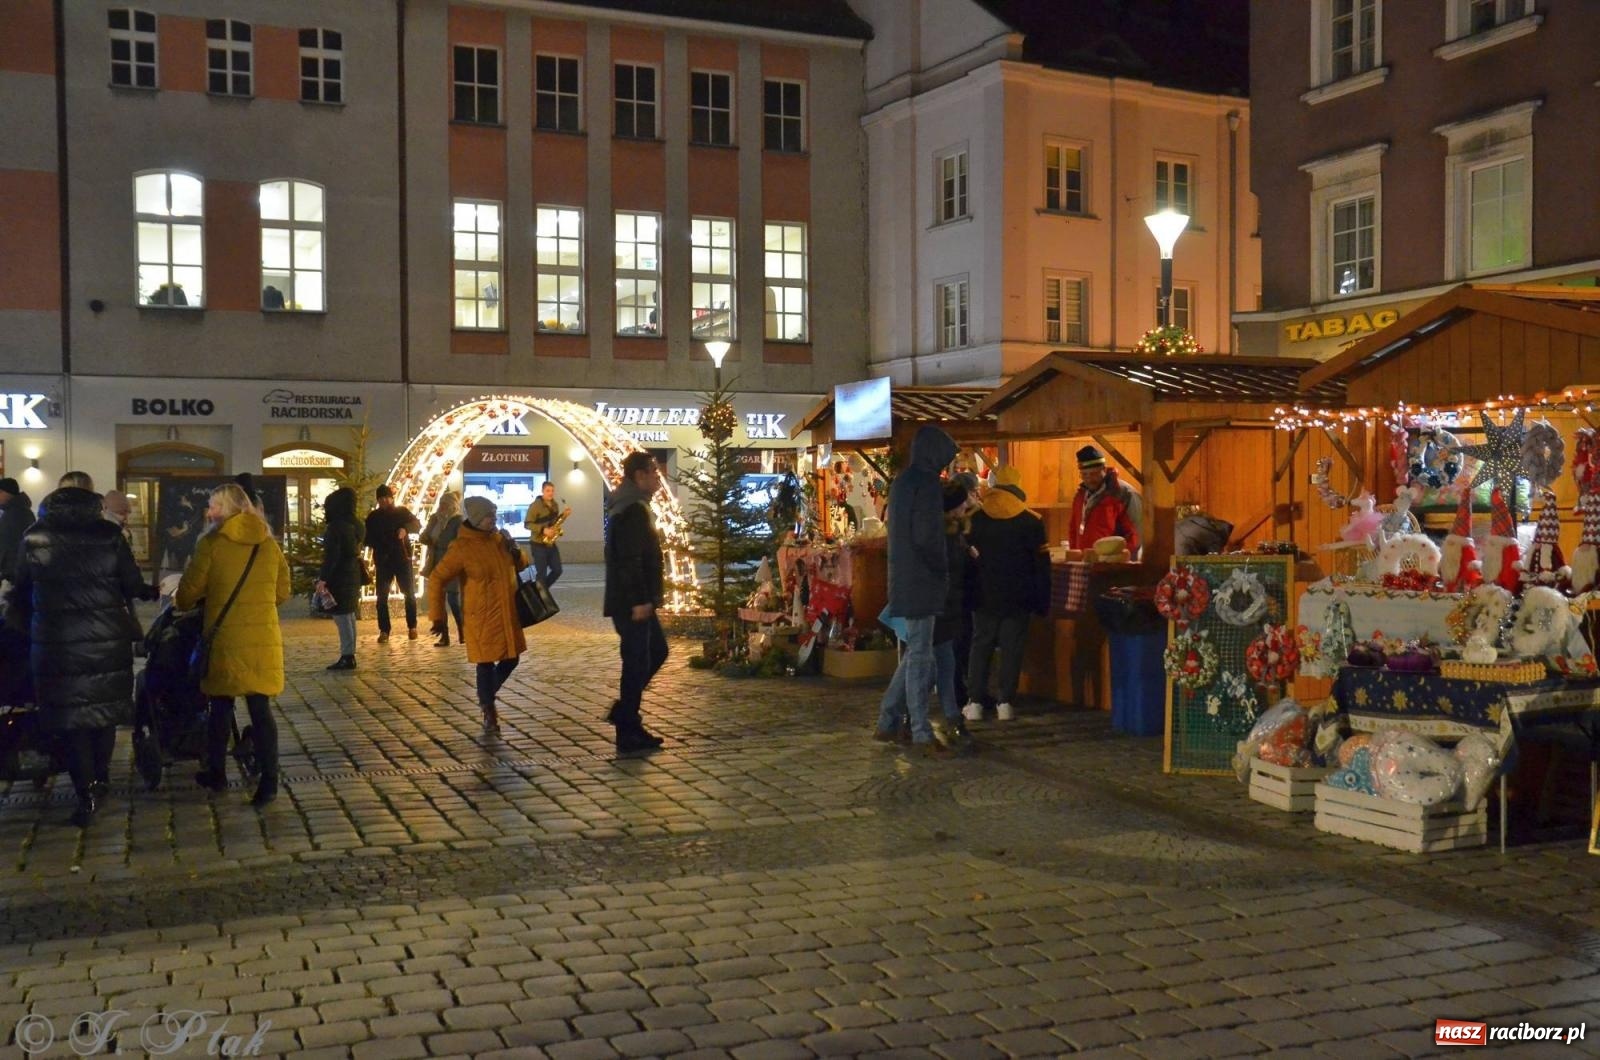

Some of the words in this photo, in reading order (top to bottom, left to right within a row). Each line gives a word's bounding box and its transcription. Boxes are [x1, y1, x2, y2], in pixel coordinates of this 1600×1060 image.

[1286, 310, 1398, 342] TABAC
[295, 395, 362, 405] RESTAURACJA
[132, 398, 215, 416] BOLKO
[271, 406, 353, 419] RACIBORSKA
[481, 452, 530, 462] ZŁOTNIK
